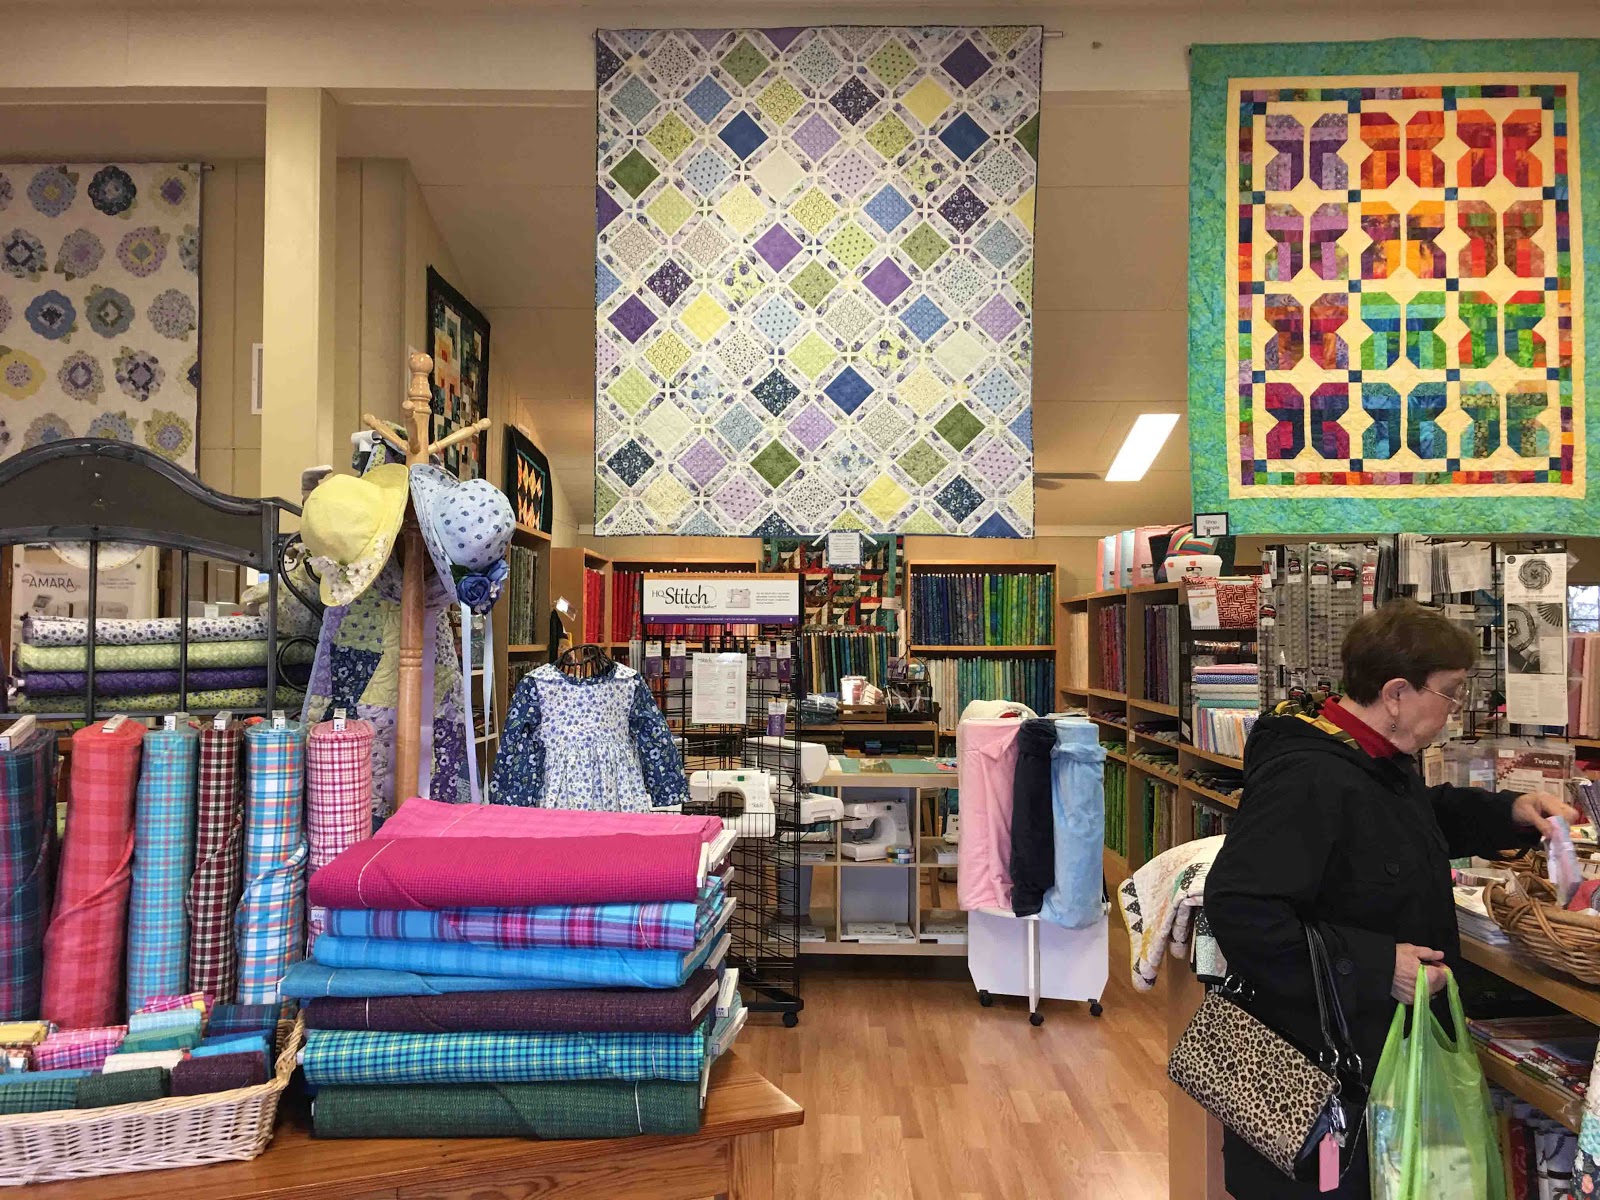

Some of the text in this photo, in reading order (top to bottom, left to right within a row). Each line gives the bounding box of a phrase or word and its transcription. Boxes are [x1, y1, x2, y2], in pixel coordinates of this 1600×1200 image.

[28, 576, 76, 591] AMARA
[651, 585, 709, 605] HQ Stitch
